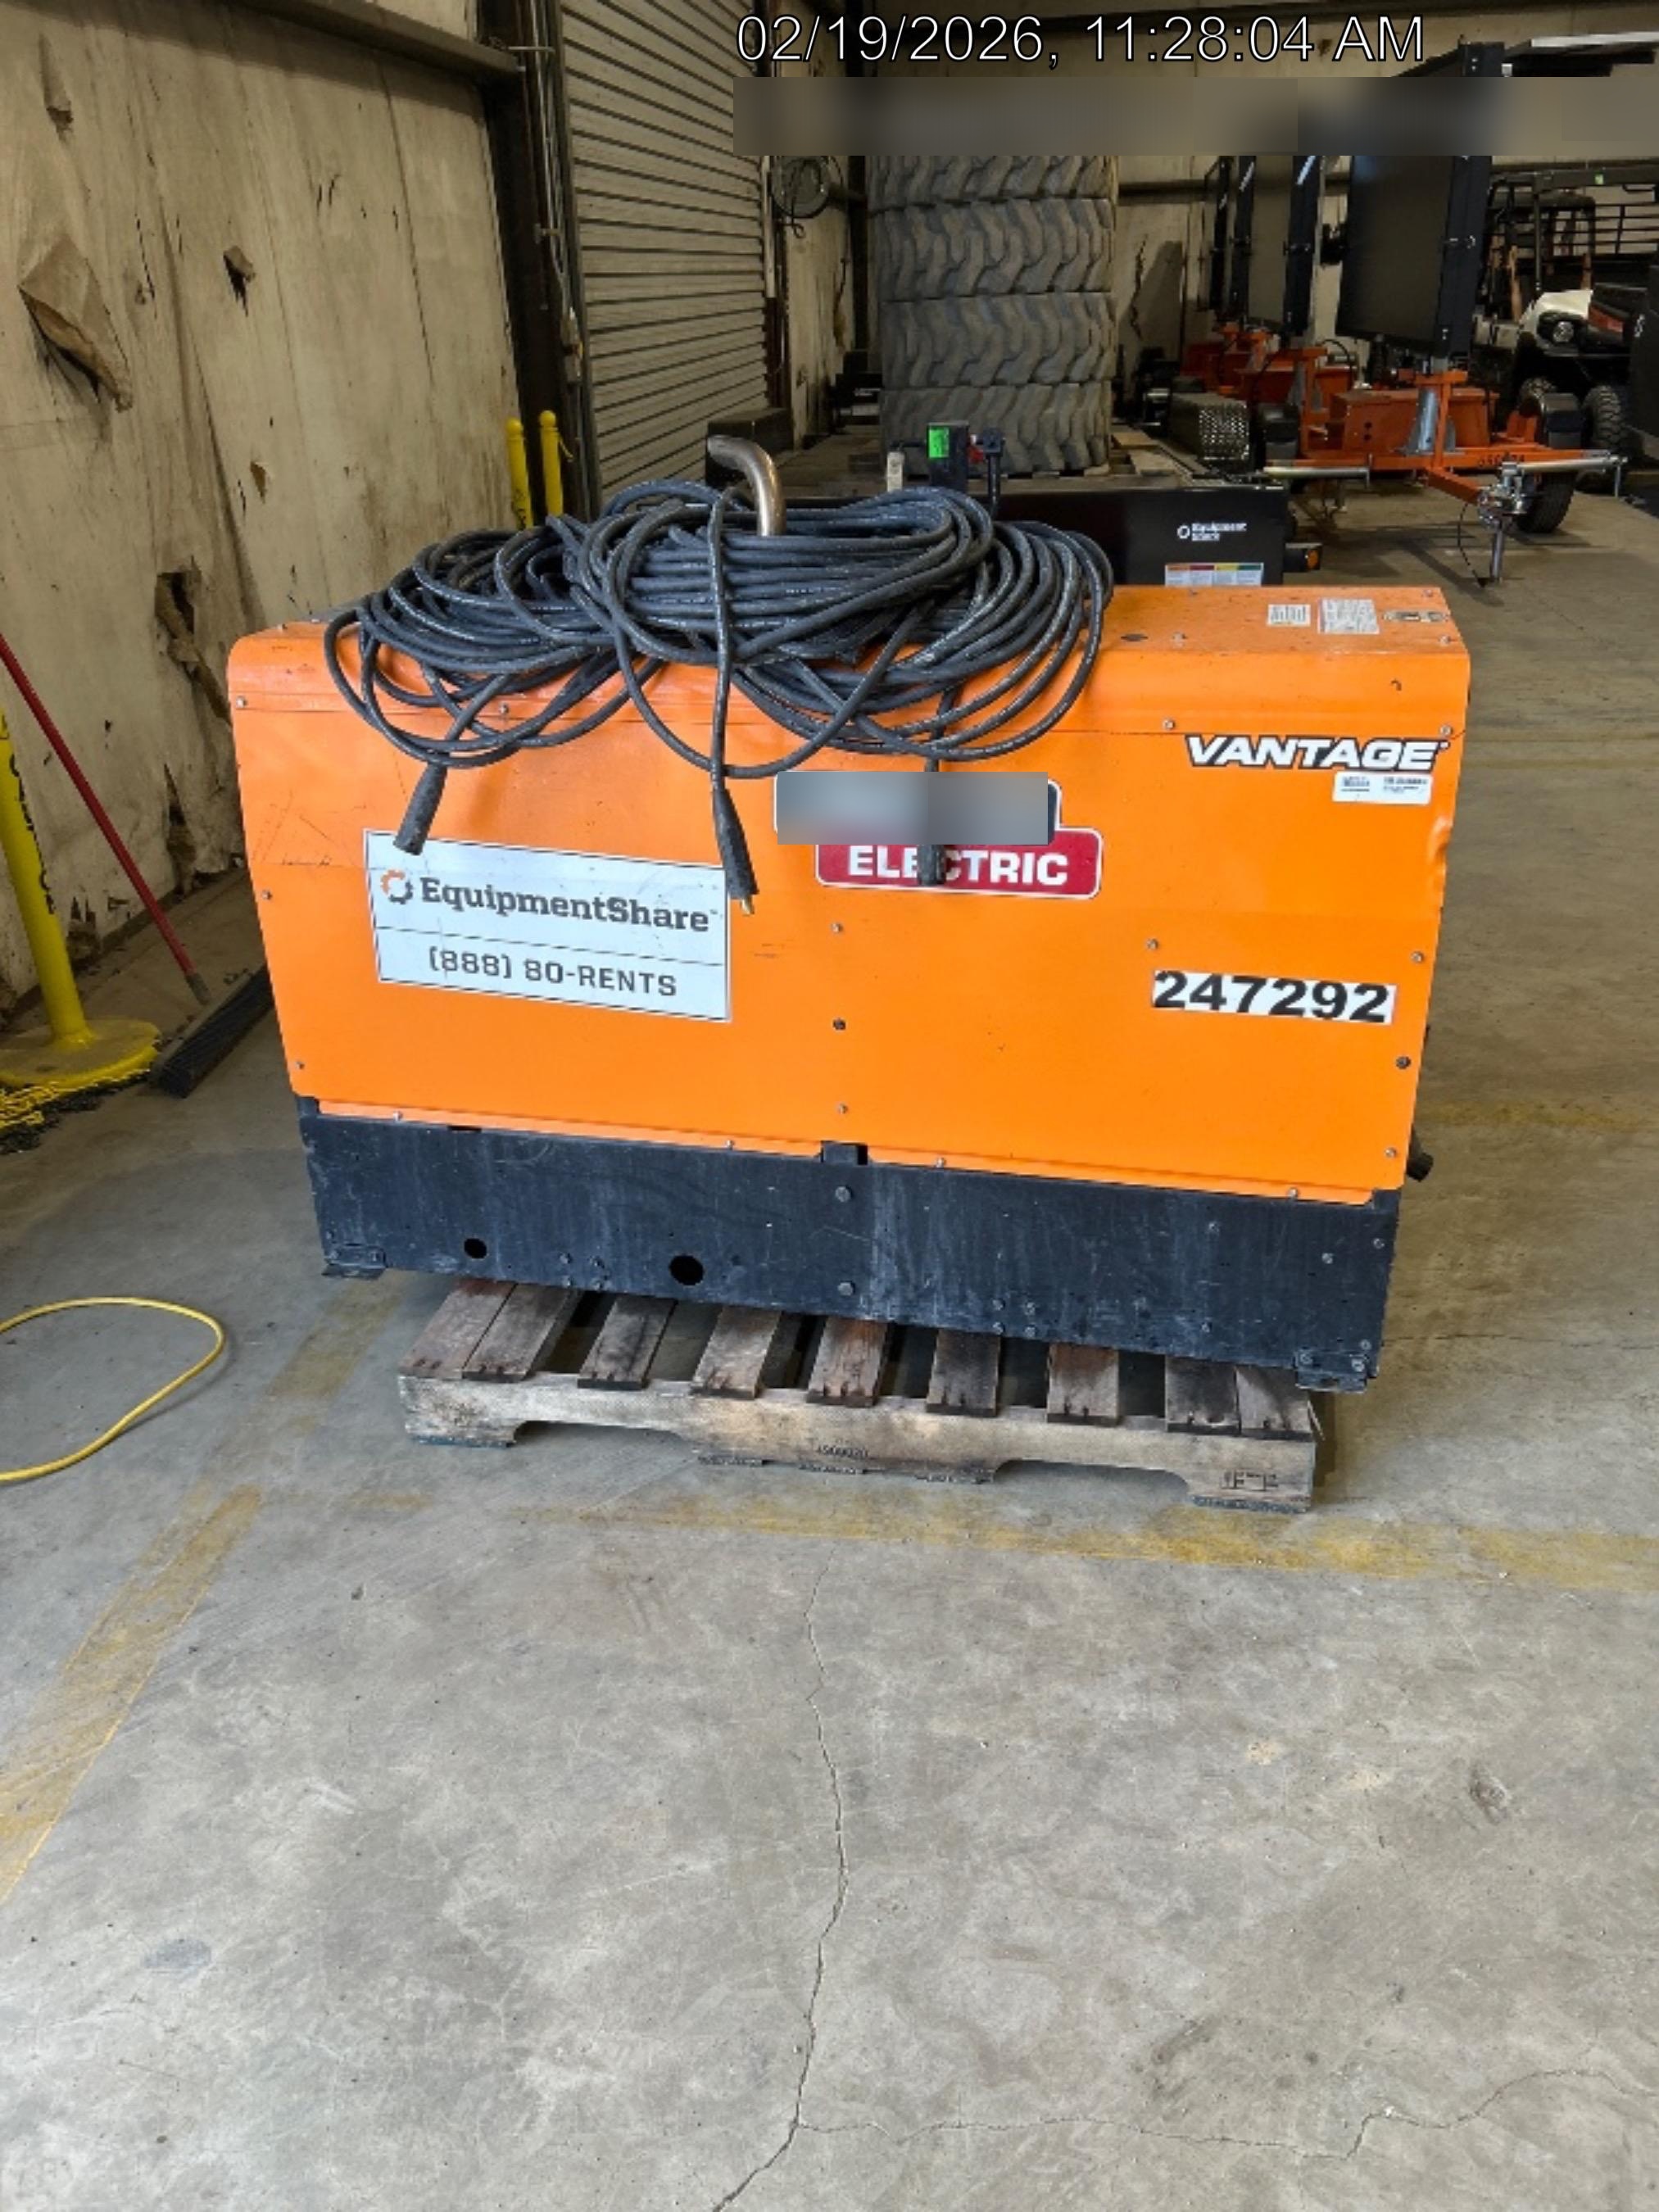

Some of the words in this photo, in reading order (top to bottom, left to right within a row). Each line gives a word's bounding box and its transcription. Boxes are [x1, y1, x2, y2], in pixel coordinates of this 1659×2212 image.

[1185, 735, 1439, 771] VANTAGE
[428, 946, 512, 979] (888)
[525, 961, 677, 996] 80-RENTS
[1154, 971, 1389, 1023] 247292
